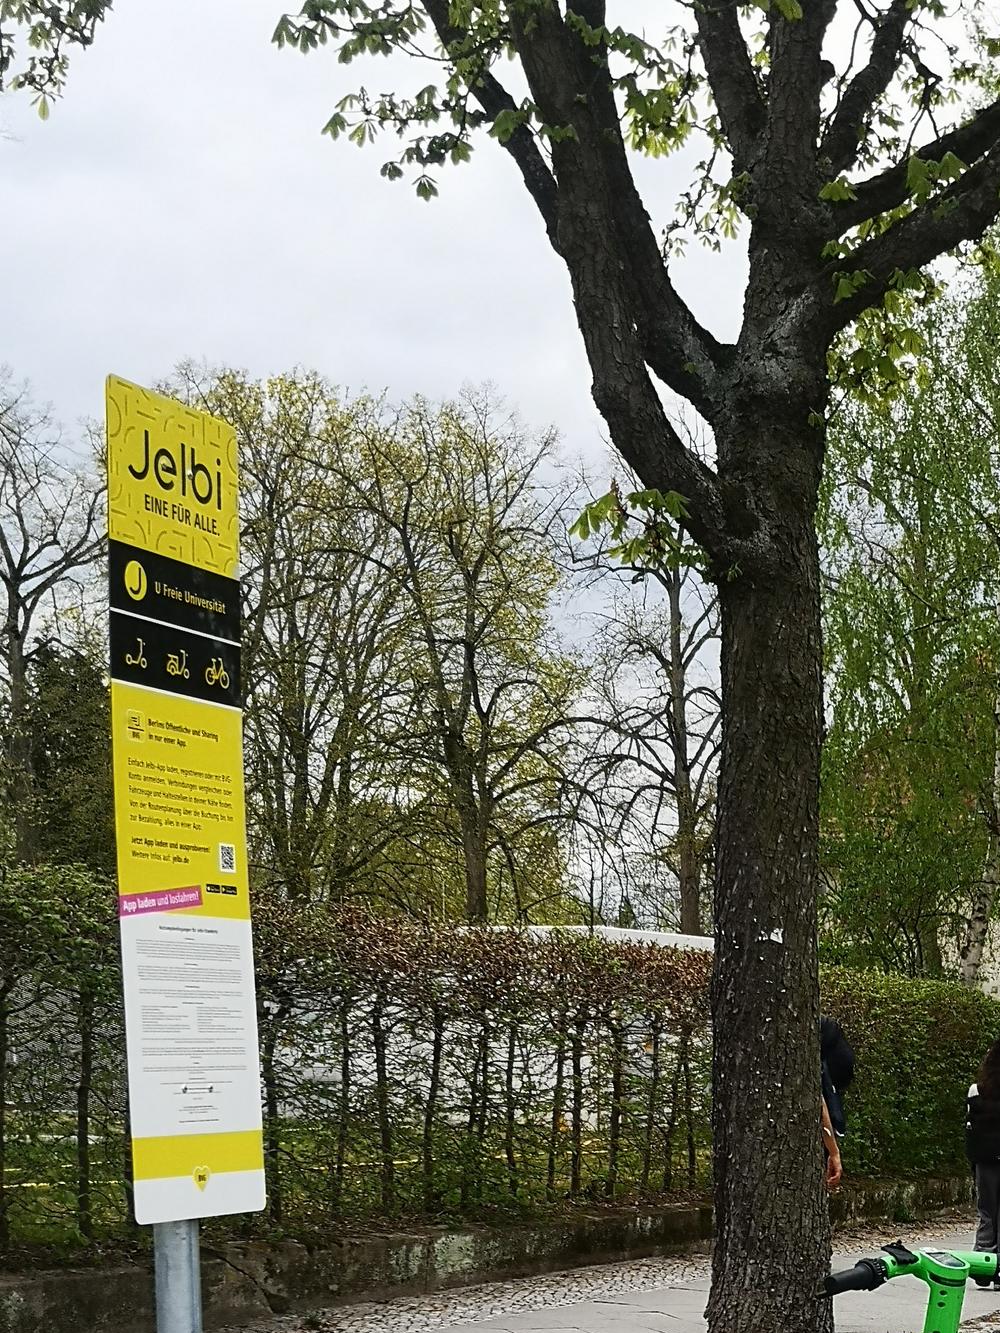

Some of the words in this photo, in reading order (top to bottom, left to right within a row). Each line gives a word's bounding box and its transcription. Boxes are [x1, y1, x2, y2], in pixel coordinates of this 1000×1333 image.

[127, 429, 222, 510] Jelbi
[144, 493, 169, 517] EINE
[171, 503, 191, 526] FÜR
[194, 513, 220, 536] ALLE.
[155, 581, 162, 594] U
[163, 583, 183, 602] Freie
[184, 590, 226, 615] Universität
[123, 899, 137, 912] App
[137, 895, 155, 909] laden
[157, 894, 168, 906] und
[169, 890, 199, 905] losfahren!
